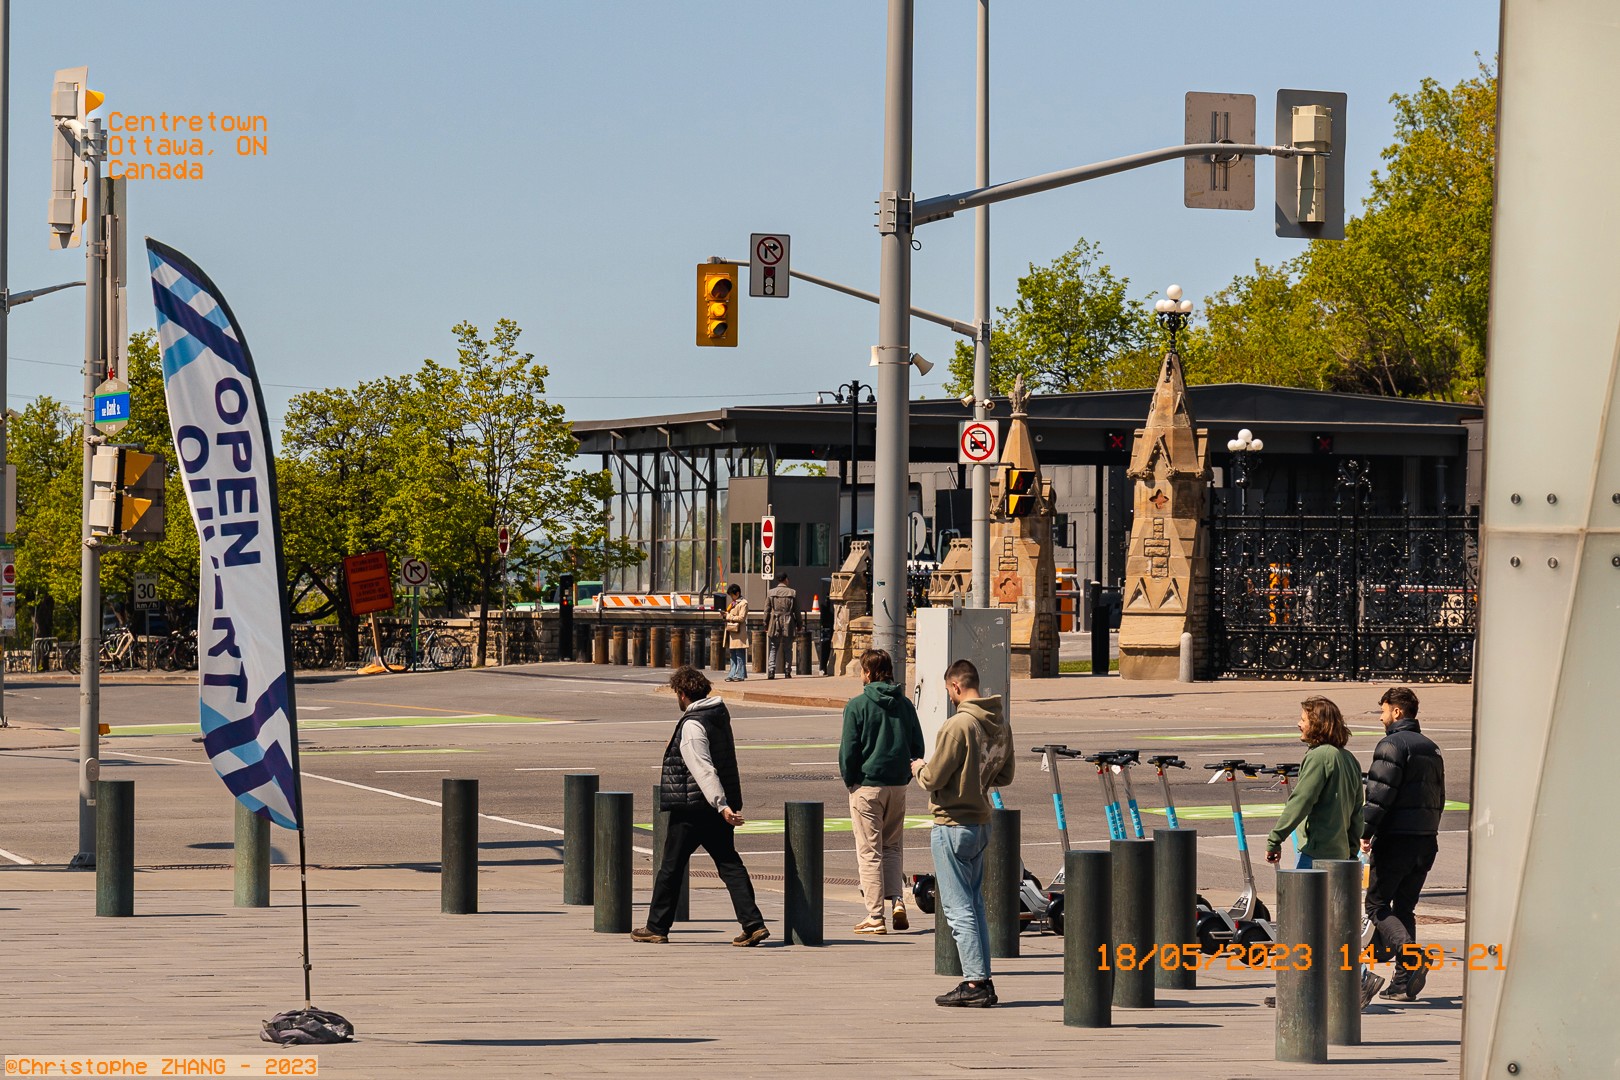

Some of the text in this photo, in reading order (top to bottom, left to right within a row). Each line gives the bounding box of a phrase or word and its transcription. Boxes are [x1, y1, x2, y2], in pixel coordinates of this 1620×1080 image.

[177, 425, 248, 703] OURT
[215, 377, 261, 567] OPEN
[138, 583, 156, 599] 30
